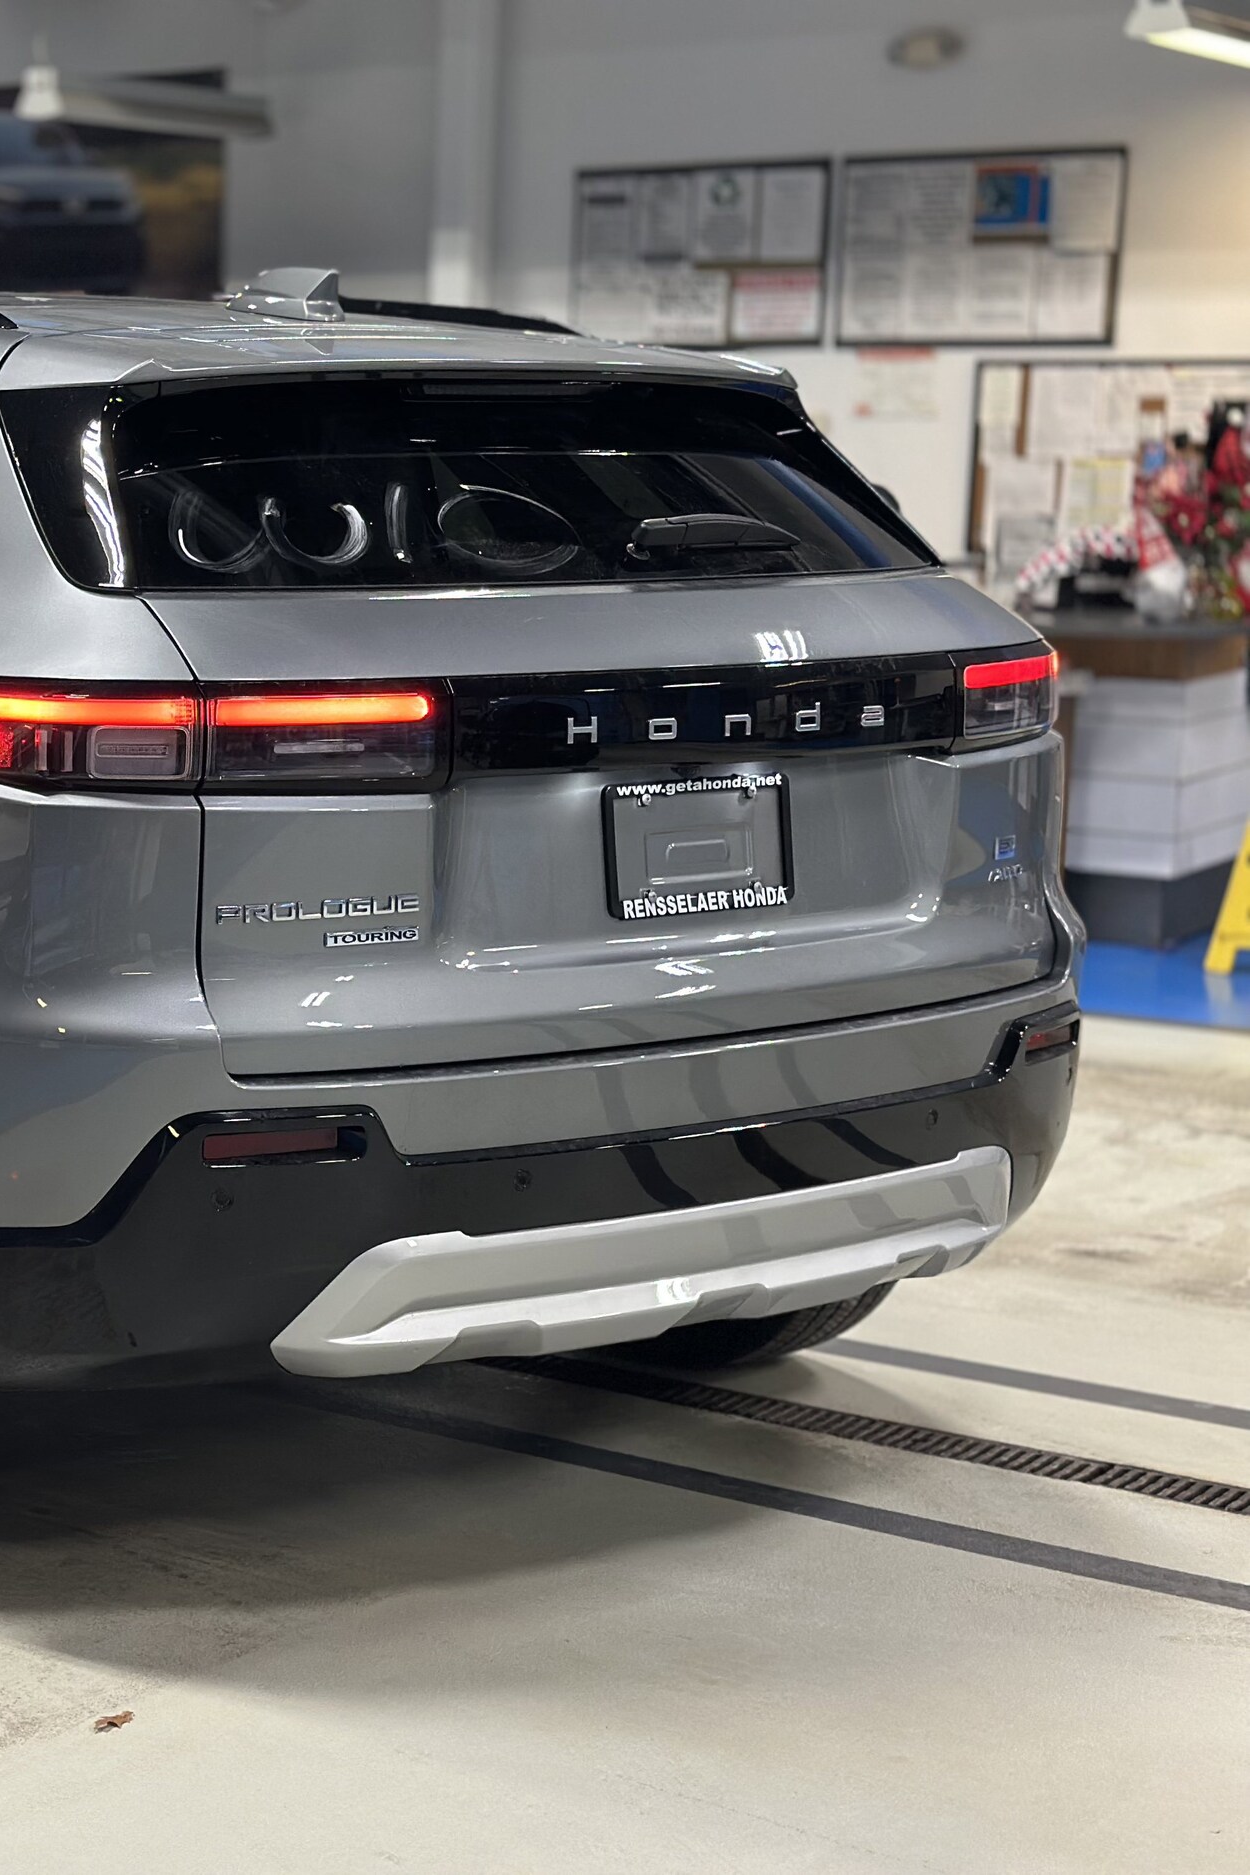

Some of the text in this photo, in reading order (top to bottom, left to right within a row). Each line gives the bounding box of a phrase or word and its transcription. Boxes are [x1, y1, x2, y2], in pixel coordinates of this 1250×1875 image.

[617, 773, 782, 797] www.getahonda.net
[216, 893, 420, 925] PROLOGUE
[623, 886, 788, 919] RENSSELAER HONDA
[331, 929, 418, 945] TOURING
